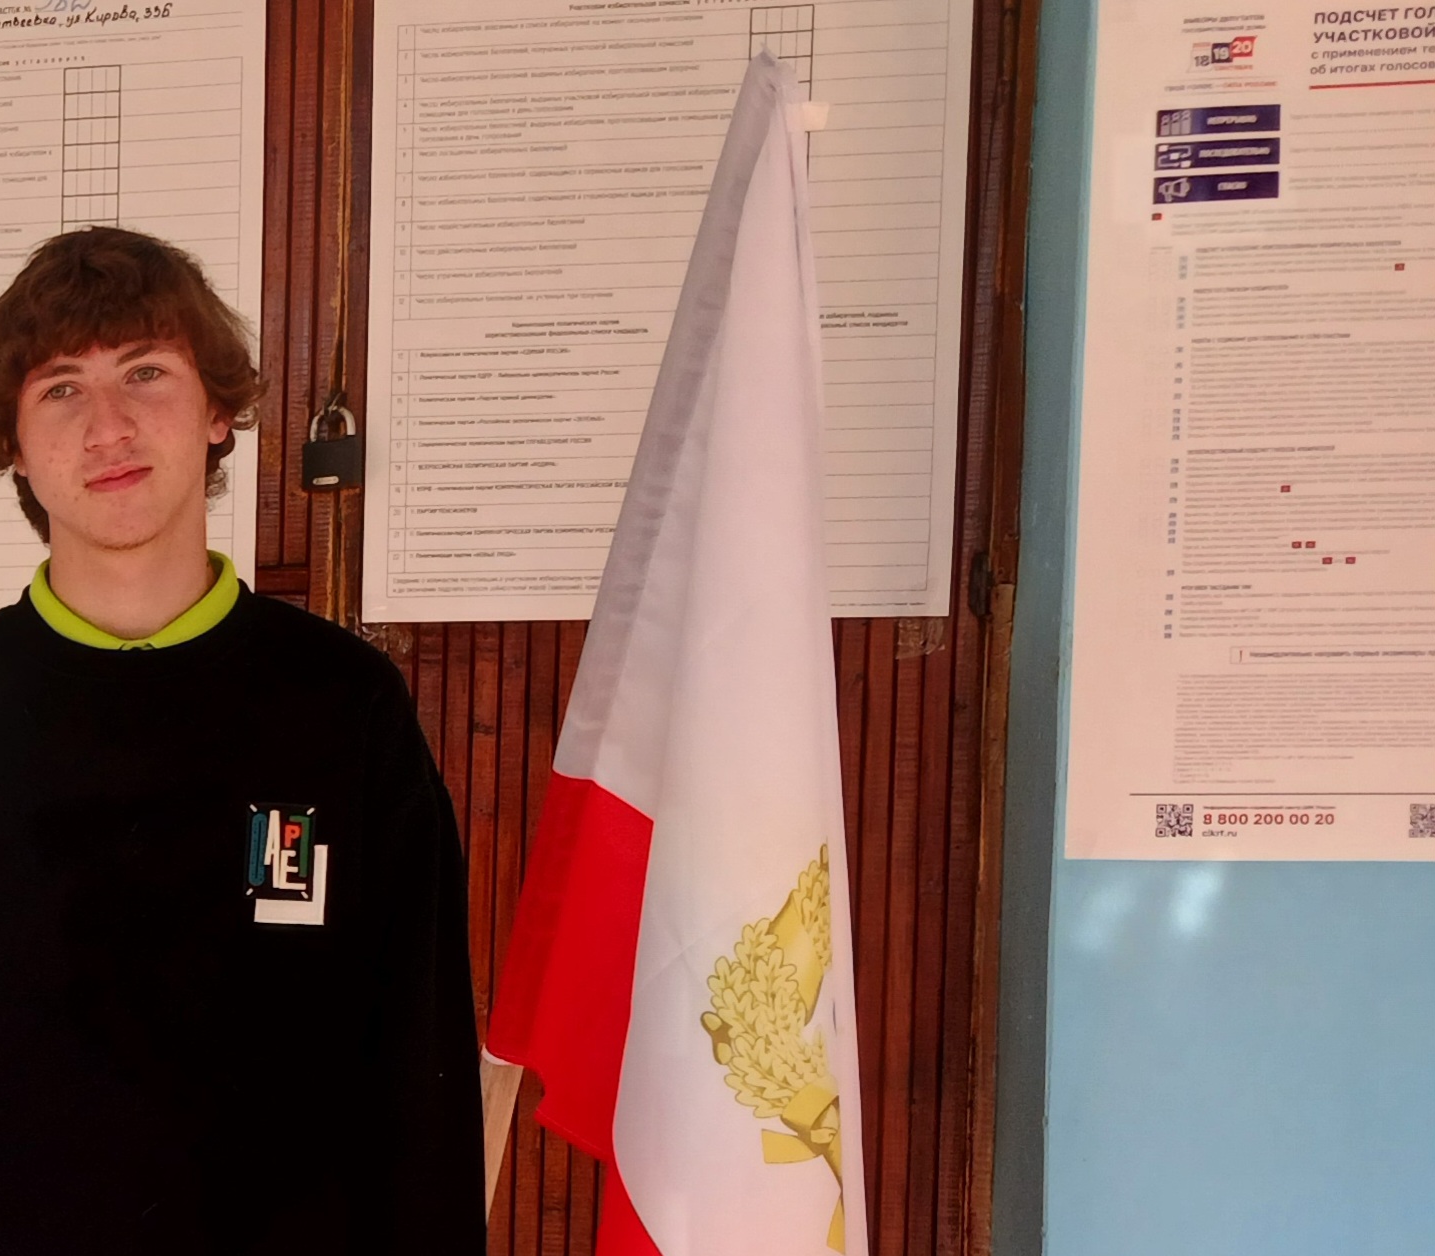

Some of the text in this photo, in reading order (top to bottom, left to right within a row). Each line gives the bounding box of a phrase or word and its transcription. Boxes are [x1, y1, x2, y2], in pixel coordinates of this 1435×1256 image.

[1313, 8, 1400, 25] ПОДСЧЕТ
[1313, 22, 1435, 43] УЧАСТКОВОЙ
[1213, 46, 1230, 60] 19
[1232, 40, 1253, 53] 20
[1322, 46, 1417, 61] применением
[1310, 64, 1326, 75] об
[1330, 64, 1376, 74] итогах
[1203, 813, 1335, 825] 8 800 200 00 20
